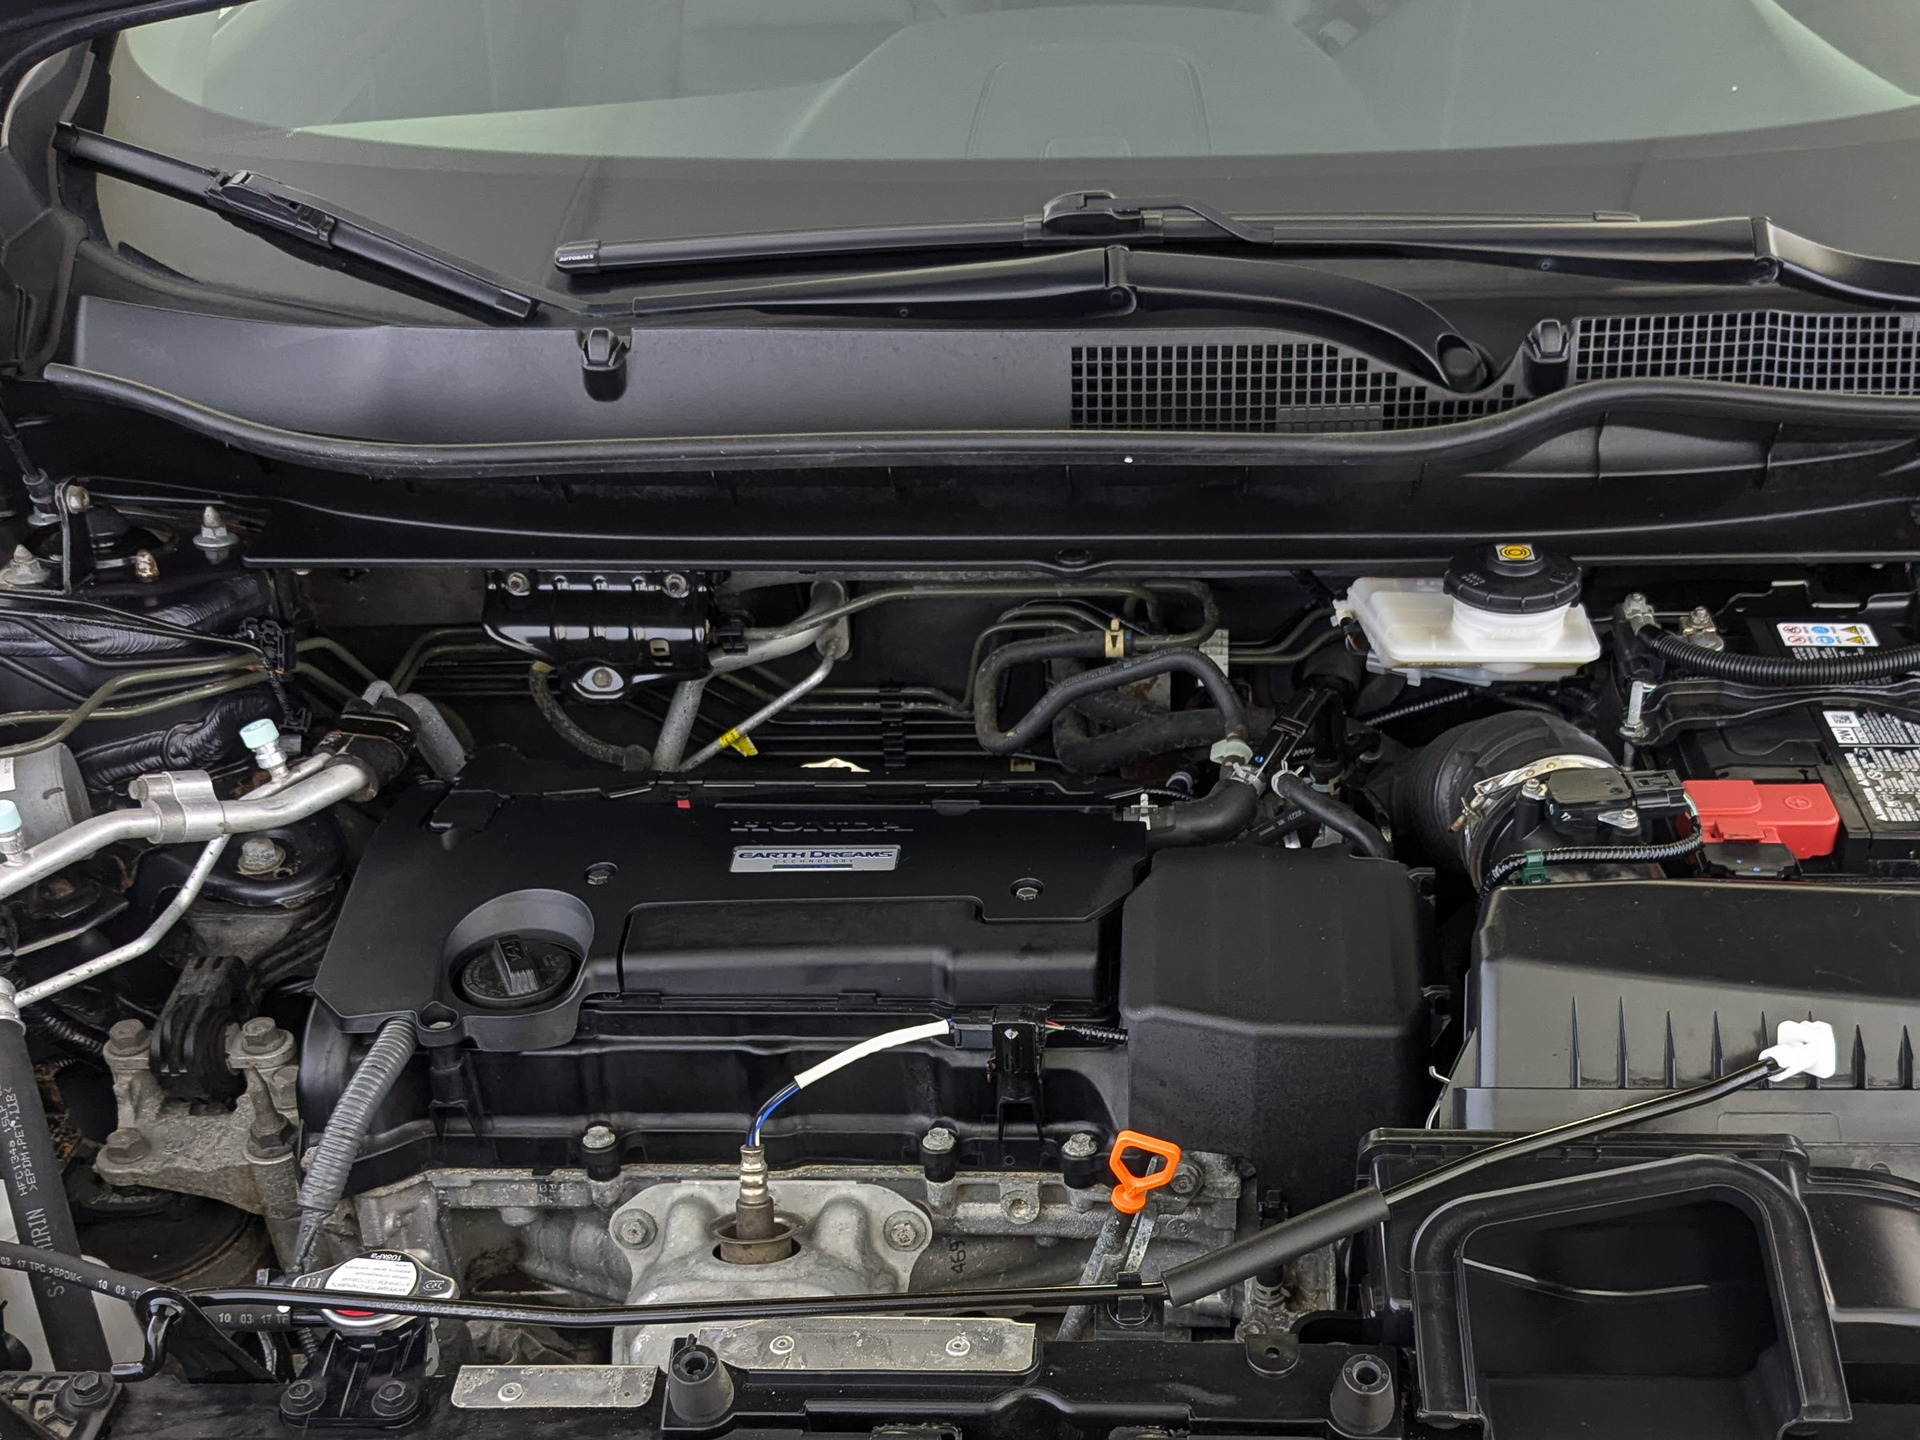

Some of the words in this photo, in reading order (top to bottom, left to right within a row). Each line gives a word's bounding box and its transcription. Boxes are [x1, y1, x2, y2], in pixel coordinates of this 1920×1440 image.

[730, 820, 914, 832] HONDA
[738, 851, 806, 859] EARTH
[809, 850, 893, 859] DREAMS
[17, 1259, 26, 1269] 17
[28, 1261, 46, 1273] TPC
[97, 1279, 108, 1290] 10
[115, 1284, 126, 1296] 03
[218, 1312, 231, 1323] 10
[240, 1313, 253, 1324] 03
[261, 1313, 272, 1324] 17
